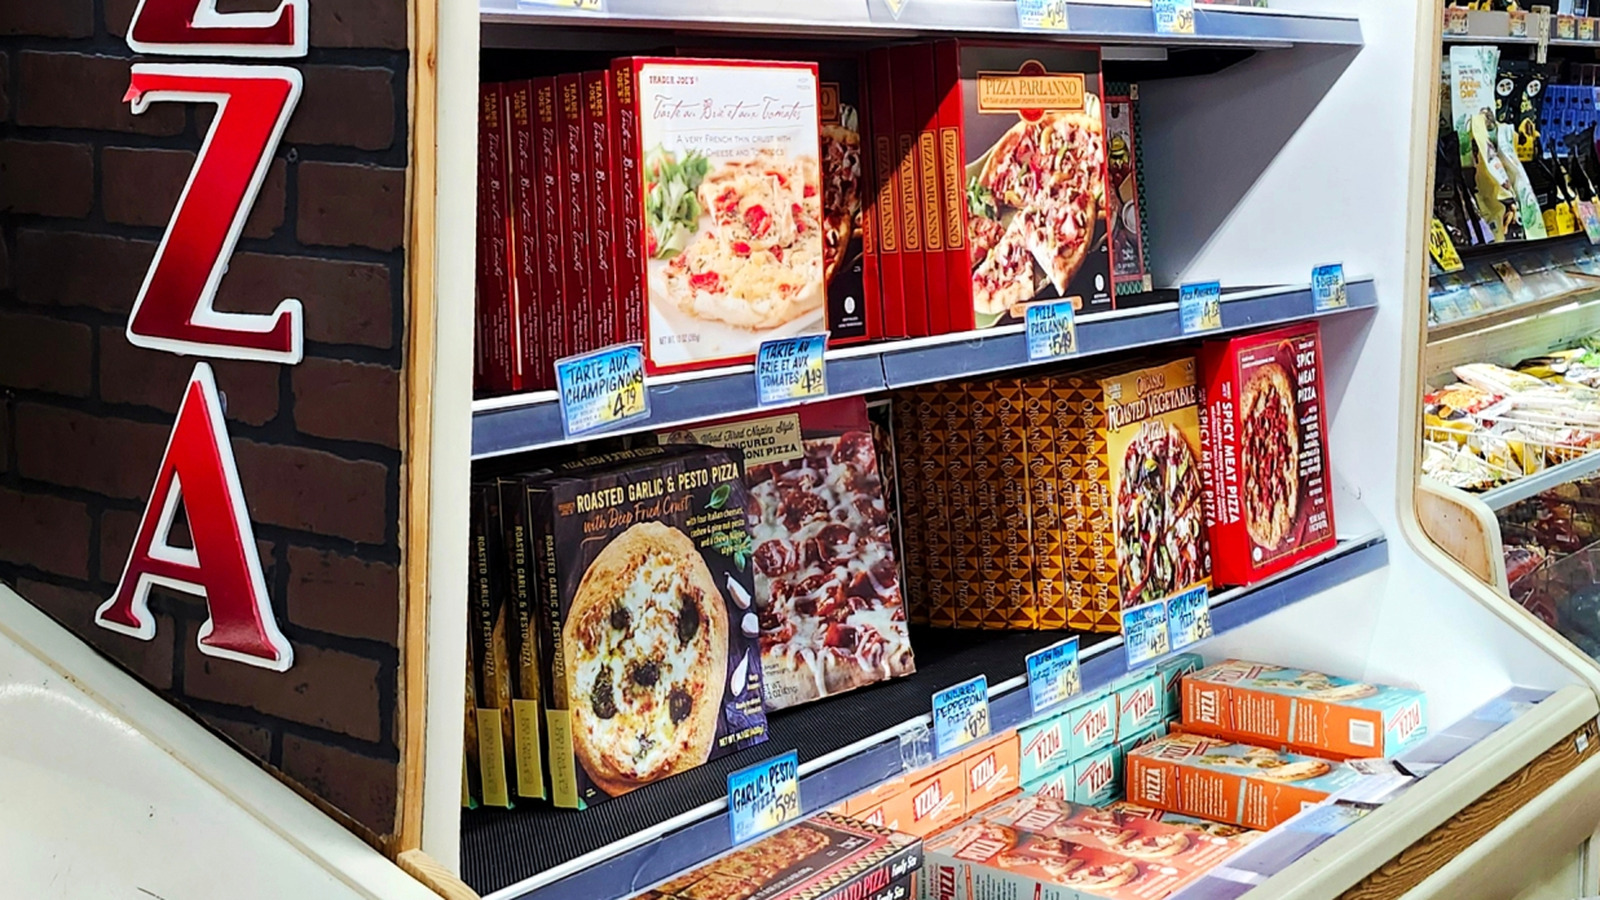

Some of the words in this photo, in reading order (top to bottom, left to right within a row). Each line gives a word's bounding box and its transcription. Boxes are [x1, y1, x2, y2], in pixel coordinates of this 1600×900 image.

[622, 67, 631, 104] TRADER
[649, 75, 675, 85] TRADER
[985, 78, 1016, 96] PIZZA
[1019, 78, 1077, 96] PARLANNO
[676, 135, 683, 143] A
[705, 134, 733, 143] FRENCH
[752, 135, 775, 143] CRUST
[923, 136, 933, 172] PIZZA
[945, 133, 955, 170] PIZZA
[760, 360, 779, 374] BRIE
[781, 359, 791, 371] ET
[763, 341, 797, 360] TARTE
[1296, 350, 1315, 368] SPICY
[566, 359, 604, 386] TARTE
[609, 352, 630, 374] AUX
[761, 371, 799, 388] TOMATES
[1298, 368, 1315, 386] MEAT
[565, 368, 643, 406] CHAMPIGNONS
[1297, 386, 1317, 403] PIZZA
[1055, 399, 1069, 453] ORGANIC
[1108, 398, 1146, 432] ROASTED
[1147, 385, 1196, 417] VEGETABLE
[1222, 402, 1235, 442] SPICY
[1081, 399, 1095, 455] ORGANIC
[1141, 418, 1167, 447] PIZZA
[766, 444, 797, 456] PIZZA
[1224, 445, 1237, 482] MEAT
[1060, 459, 1073, 509] ROASTED
[1086, 460, 1099, 510] ROASTED
[1202, 451, 1213, 487] MEAT
[576, 486, 625, 514] ROASTED
[628, 478, 664, 502] GARLIC
[666, 476, 675, 493] &
[678, 468, 708, 490] PESTO
[711, 462, 740, 484] PIZZA
[1227, 486, 1240, 524] PIZZA
[583, 512, 607, 534] with
[608, 506, 633, 528] Deep
[634, 502, 660, 521] Fried
[663, 495, 694, 516] Crust
[1206, 490, 1216, 528] PIZZA
[545, 534, 556, 574] ROASTED
[1065, 515, 1079, 574] VEGETABLE
[1091, 515, 1105, 575] VEGETABLE
[548, 577, 559, 609] GARLIC
[1070, 581, 1082, 612] PIZZA
[1096, 583, 1108, 613] PIZZA
[552, 620, 562, 650] PESTO
[554, 650, 565, 678] PIZZA
[935, 690, 985, 718] PEPPERONI
[947, 708, 971, 727] PIZZA
[1134, 686, 1154, 721] PIZZA
[1201, 691, 1215, 723] PIZZA
[1399, 701, 1421, 739] PIZZA
[1085, 705, 1107, 742] PIZZA
[1037, 725, 1060, 764] PIZZA
[733, 774, 764, 813] GARLIC
[769, 761, 794, 788] PESTO
[1088, 756, 1112, 793] PIZZA
[1147, 768, 1161, 802] PIZZA
[752, 786, 776, 818] PIZZA
[863, 865, 891, 898] PIZZA
[940, 866, 955, 900] PIZZA
